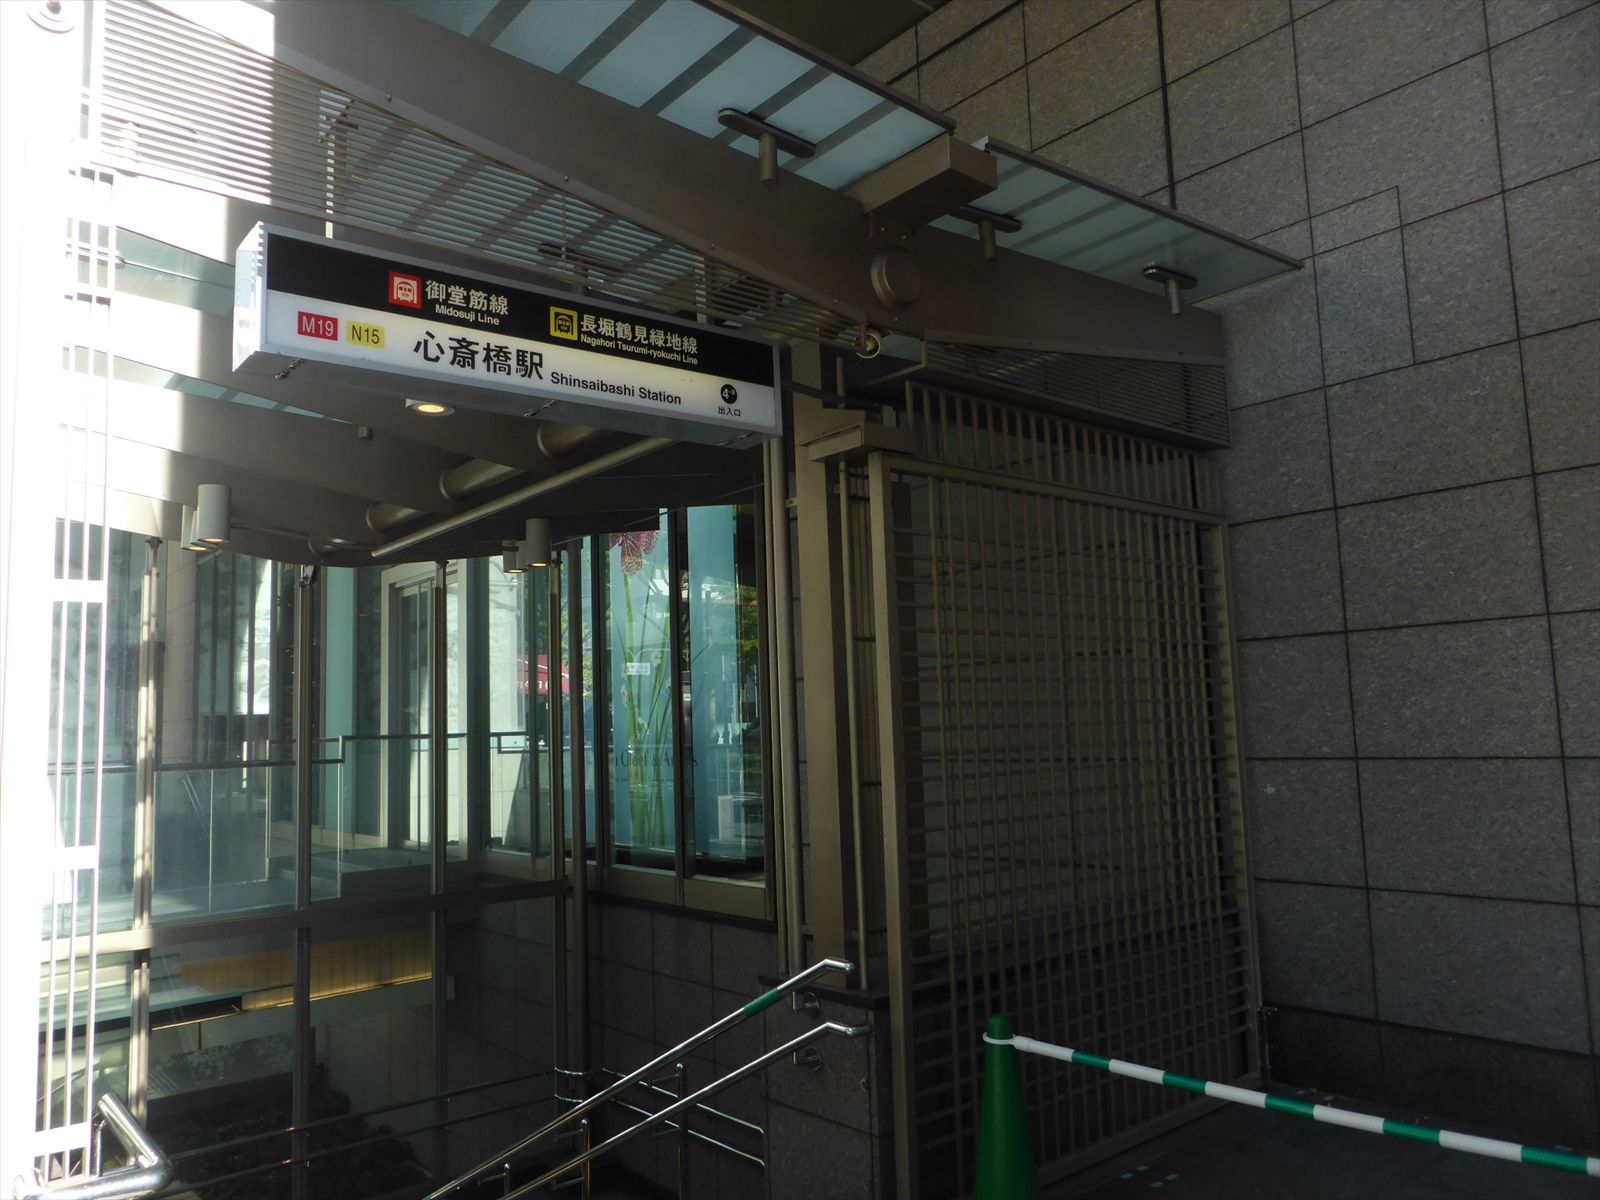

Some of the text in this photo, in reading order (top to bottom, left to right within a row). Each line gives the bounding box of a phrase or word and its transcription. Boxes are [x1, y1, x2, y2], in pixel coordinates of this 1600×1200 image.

[425, 280, 509, 315] 御堂筋線
[302, 317, 334, 336] M19
[435, 304, 500, 326] Midosuji Line
[351, 325, 380, 345] N15
[580, 314, 698, 354] 長堀鶴見緑地線
[580, 334, 698, 365] Nagahori Tsurumi-ryokuchi Line
[413, 331, 543, 380] 心斎橋駅
[551, 371, 682, 405] Shinsaibashi Station
[718, 405, 741, 417] 出入口
